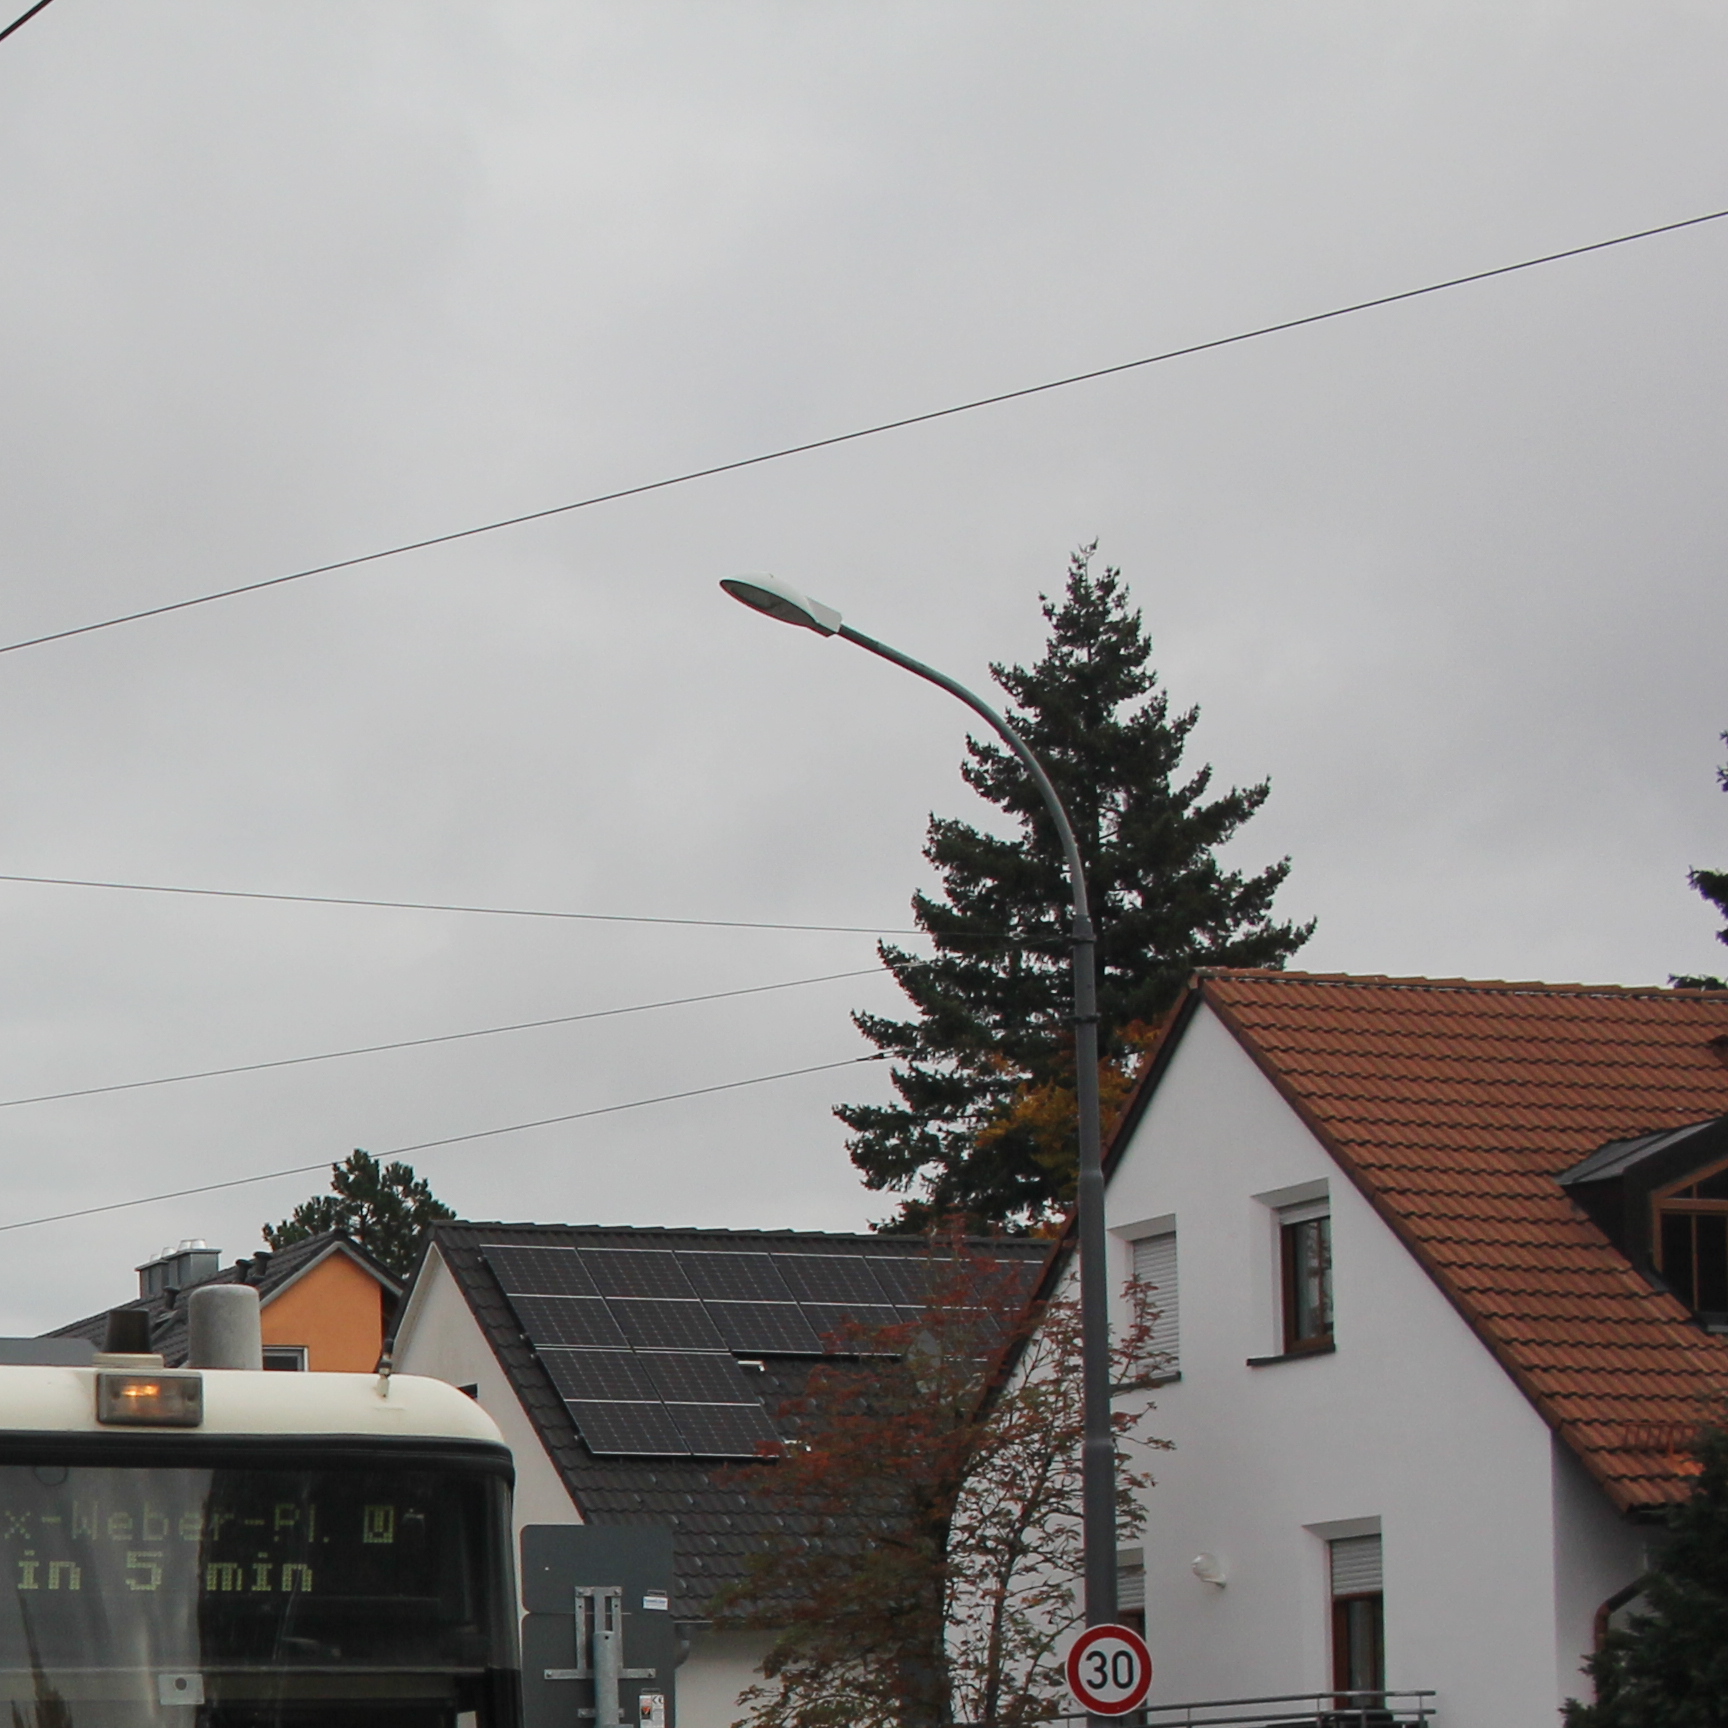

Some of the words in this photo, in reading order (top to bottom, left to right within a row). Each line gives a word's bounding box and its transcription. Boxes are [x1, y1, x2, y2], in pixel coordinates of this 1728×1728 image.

[17, 1549, 82, 1591] in
[124, 1549, 165, 1591] 5
[205, 1551, 314, 1593] min
[1085, 1650, 1135, 1690] 30
